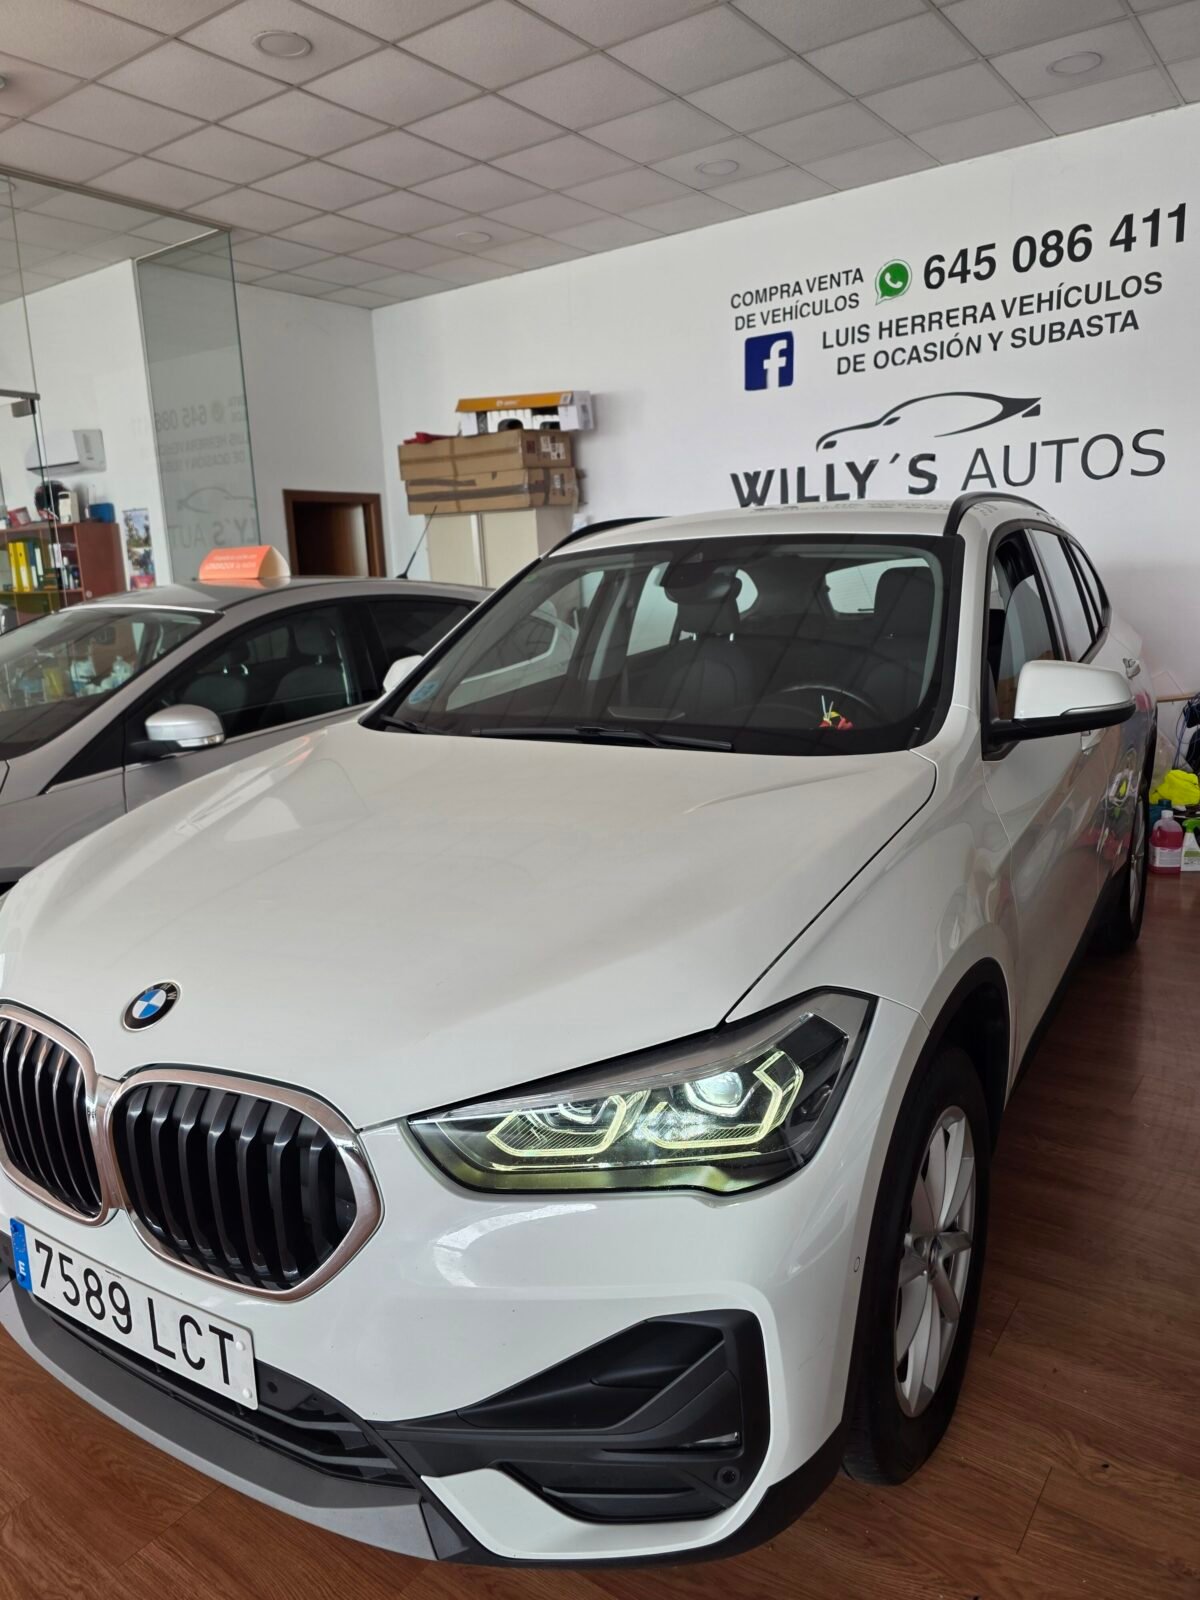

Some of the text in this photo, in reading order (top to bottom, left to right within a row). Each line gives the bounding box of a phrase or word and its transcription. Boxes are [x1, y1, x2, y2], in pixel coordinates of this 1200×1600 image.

[923, 202, 1187, 289] 645 086 411
[730, 267, 864, 309] COMPRA VENTA
[735, 292, 861, 331] DE VEHÍCULOS
[822, 271, 1163, 350] LUIS HERRERA VEHÍCULOS
[836, 309, 1139, 375] DE OCASIÓN Y SUBASTA
[960, 429, 1166, 492] AUTOS
[18, 1260, 26, 1276] E
[34, 1239, 234, 1385] 7589 LCT
